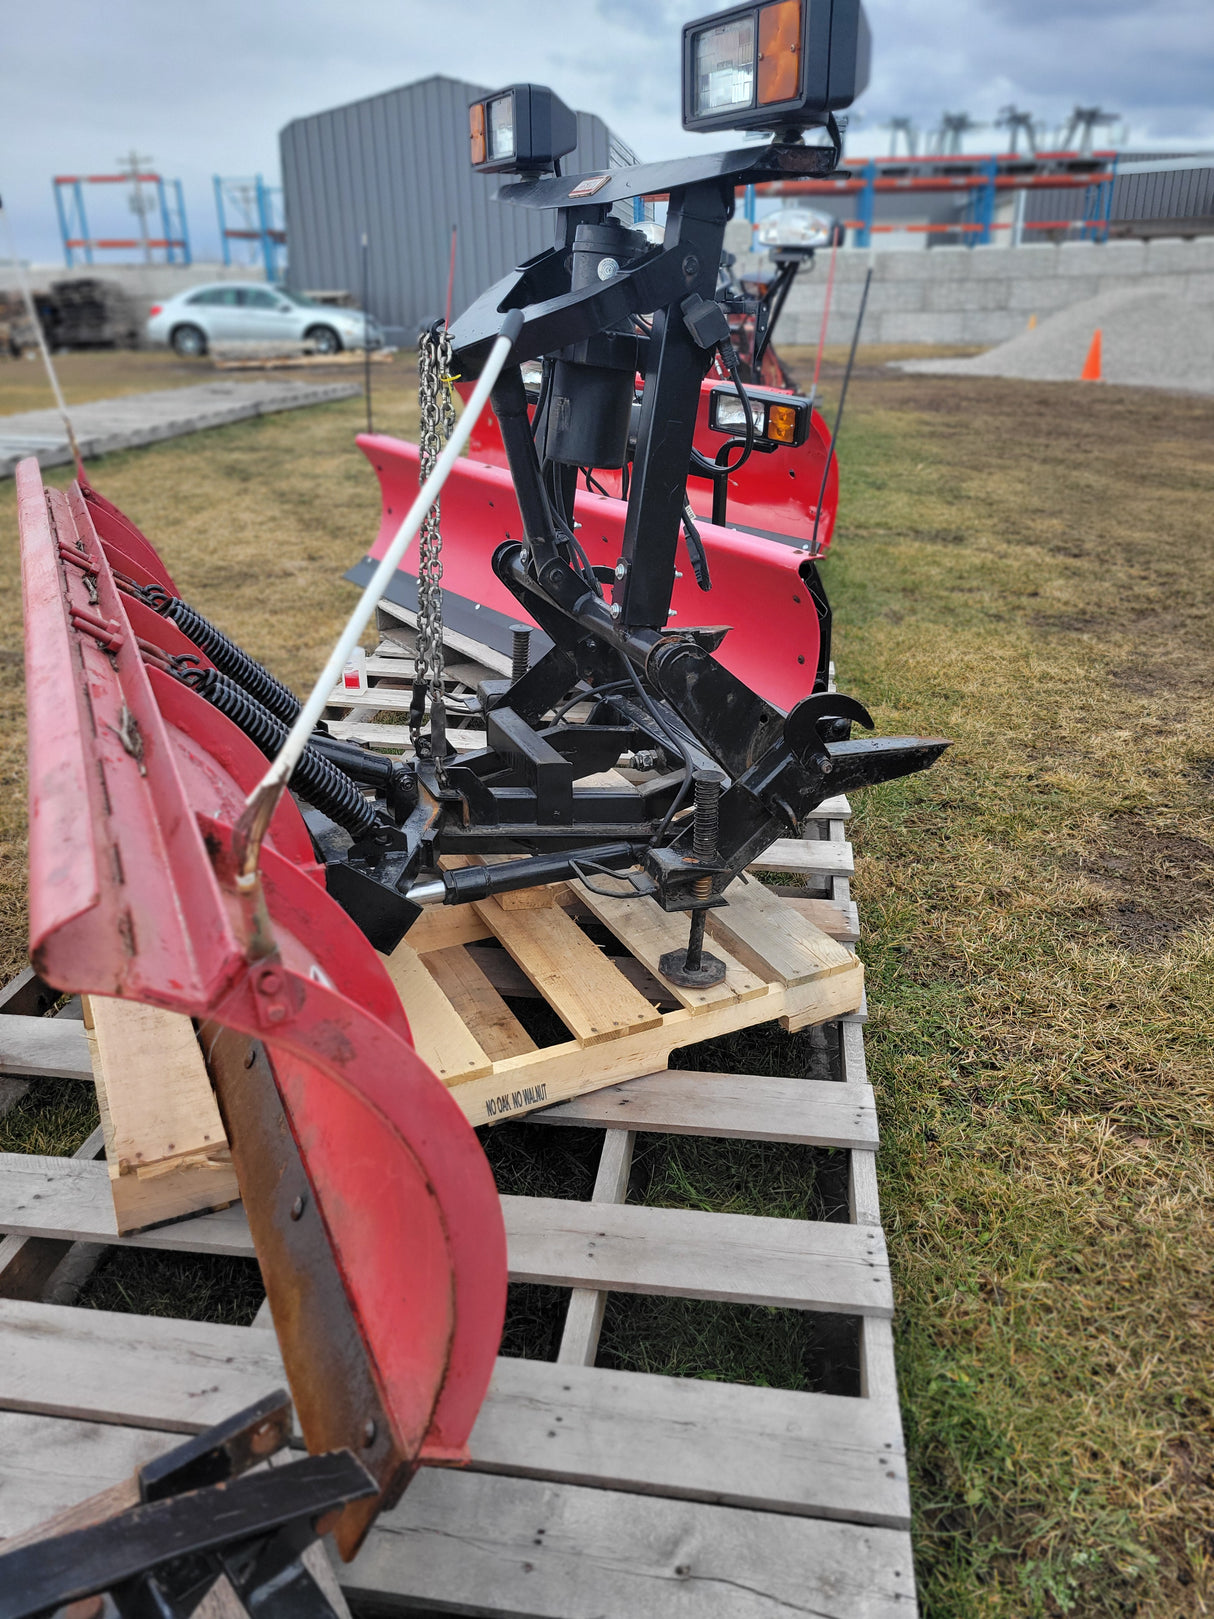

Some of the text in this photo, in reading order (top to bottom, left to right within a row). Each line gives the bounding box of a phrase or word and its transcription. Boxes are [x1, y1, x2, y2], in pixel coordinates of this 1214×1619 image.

[486, 1083, 548, 1117] NO OAK NO WALNUT
